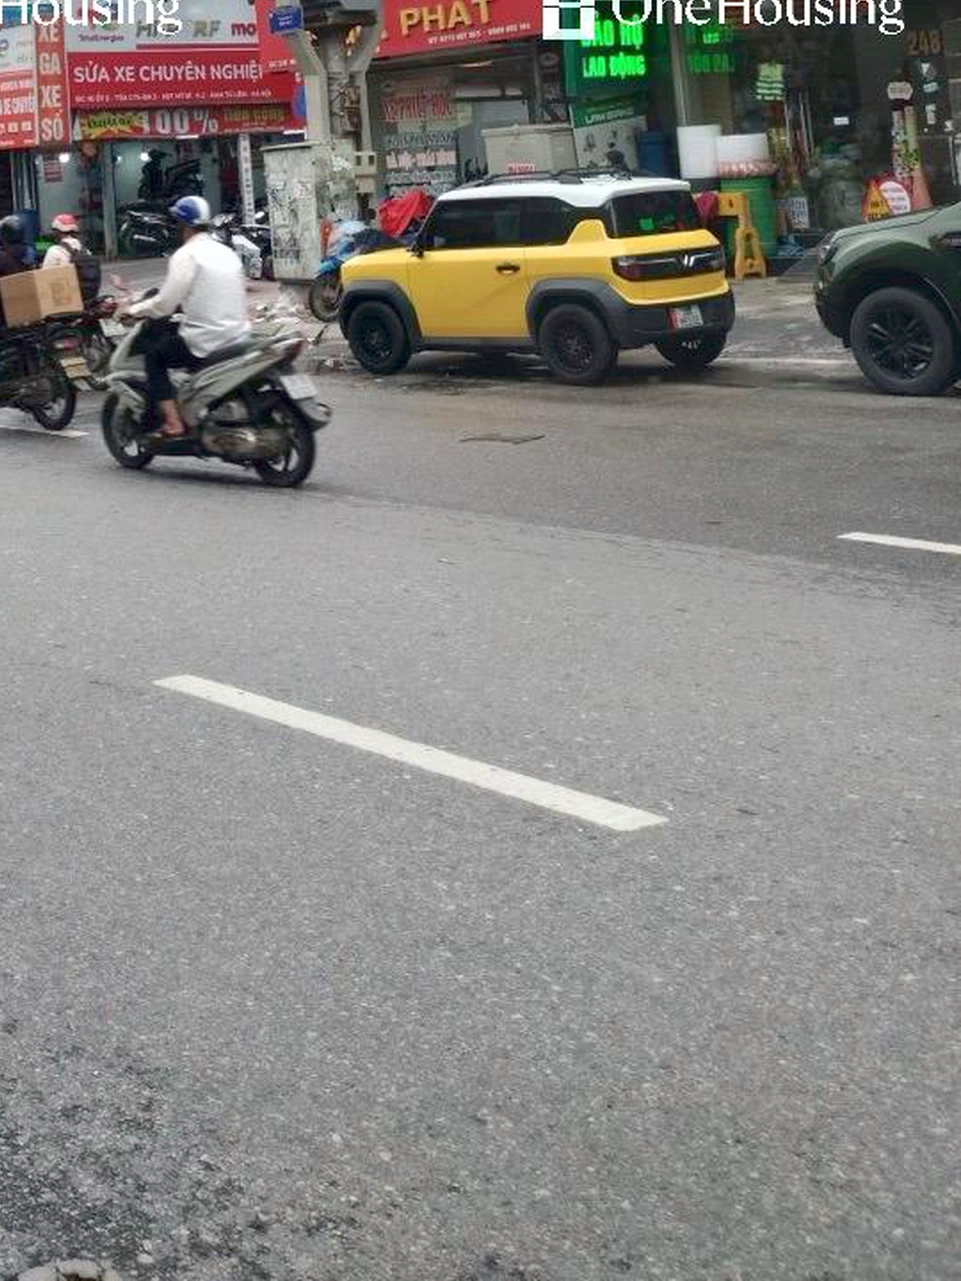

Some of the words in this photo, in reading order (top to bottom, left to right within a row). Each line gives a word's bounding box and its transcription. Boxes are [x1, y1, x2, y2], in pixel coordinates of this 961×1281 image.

[39, 54, 61, 75] GA
[73, 59, 110, 84] SỬA
[114, 65, 135, 83] XE
[138, 59, 207, 82] CHUYÊN
[210, 59, 263, 84] NGHIỆ
[40, 85, 61, 108] XE
[41, 108, 64, 141] SỐ
